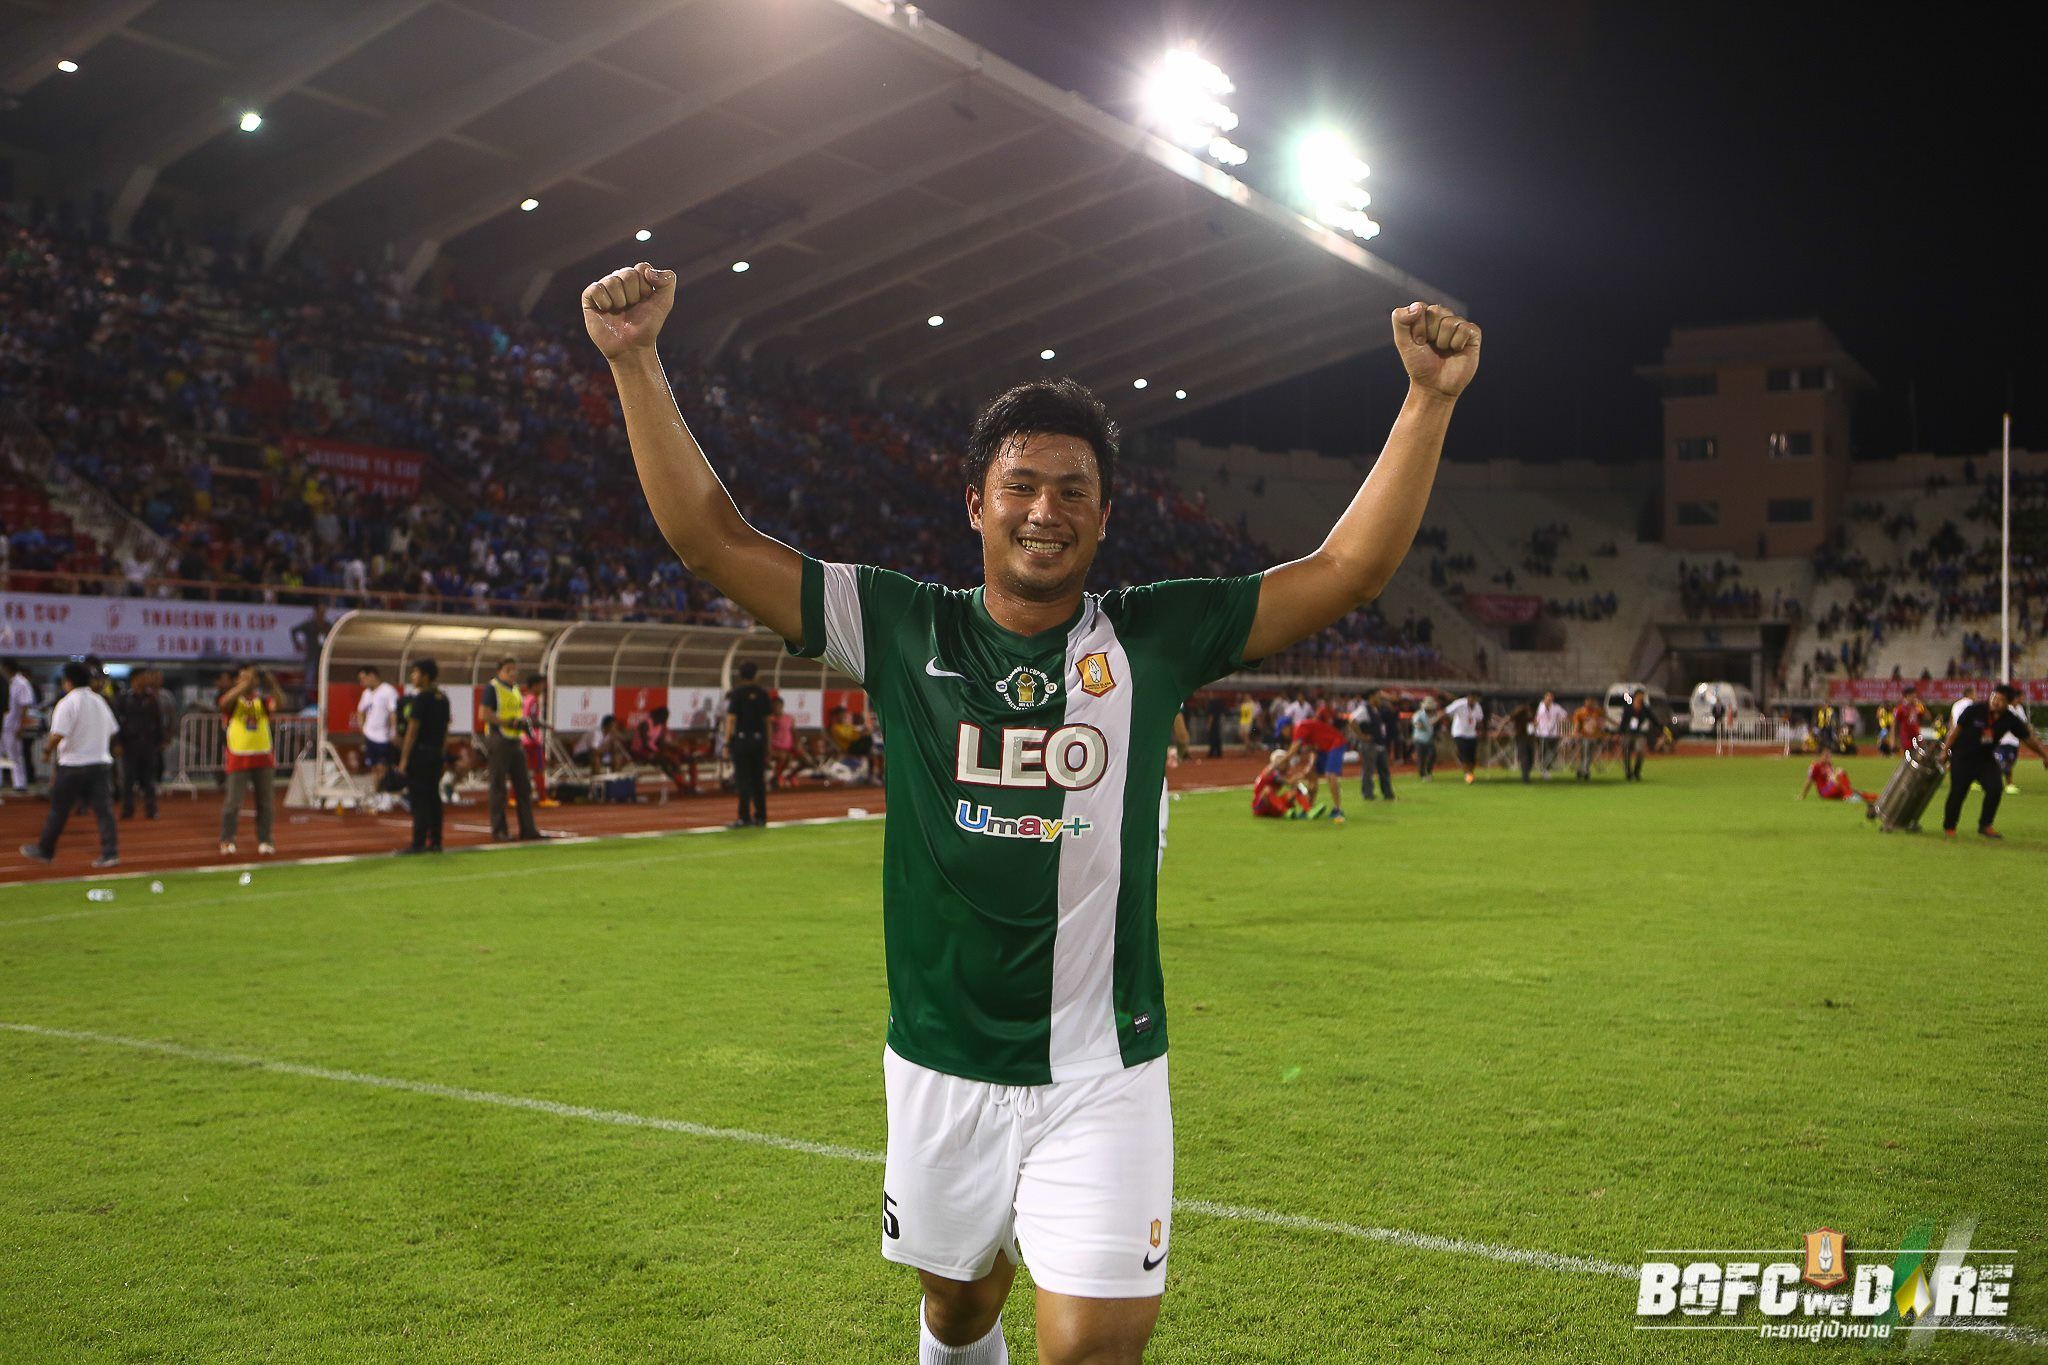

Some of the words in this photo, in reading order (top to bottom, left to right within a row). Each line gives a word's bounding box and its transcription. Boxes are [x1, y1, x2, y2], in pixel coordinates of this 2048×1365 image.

[5, 602, 26, 622] FA
[33, 603, 71, 623] CUP
[141, 607, 216, 629] THAICOM
[223, 612, 241, 631] FA
[247, 612, 278, 630] CUP
[220, 637, 264, 655] 2014
[955, 721, 1109, 790] LEO
[955, 799, 1093, 842] Umay+
